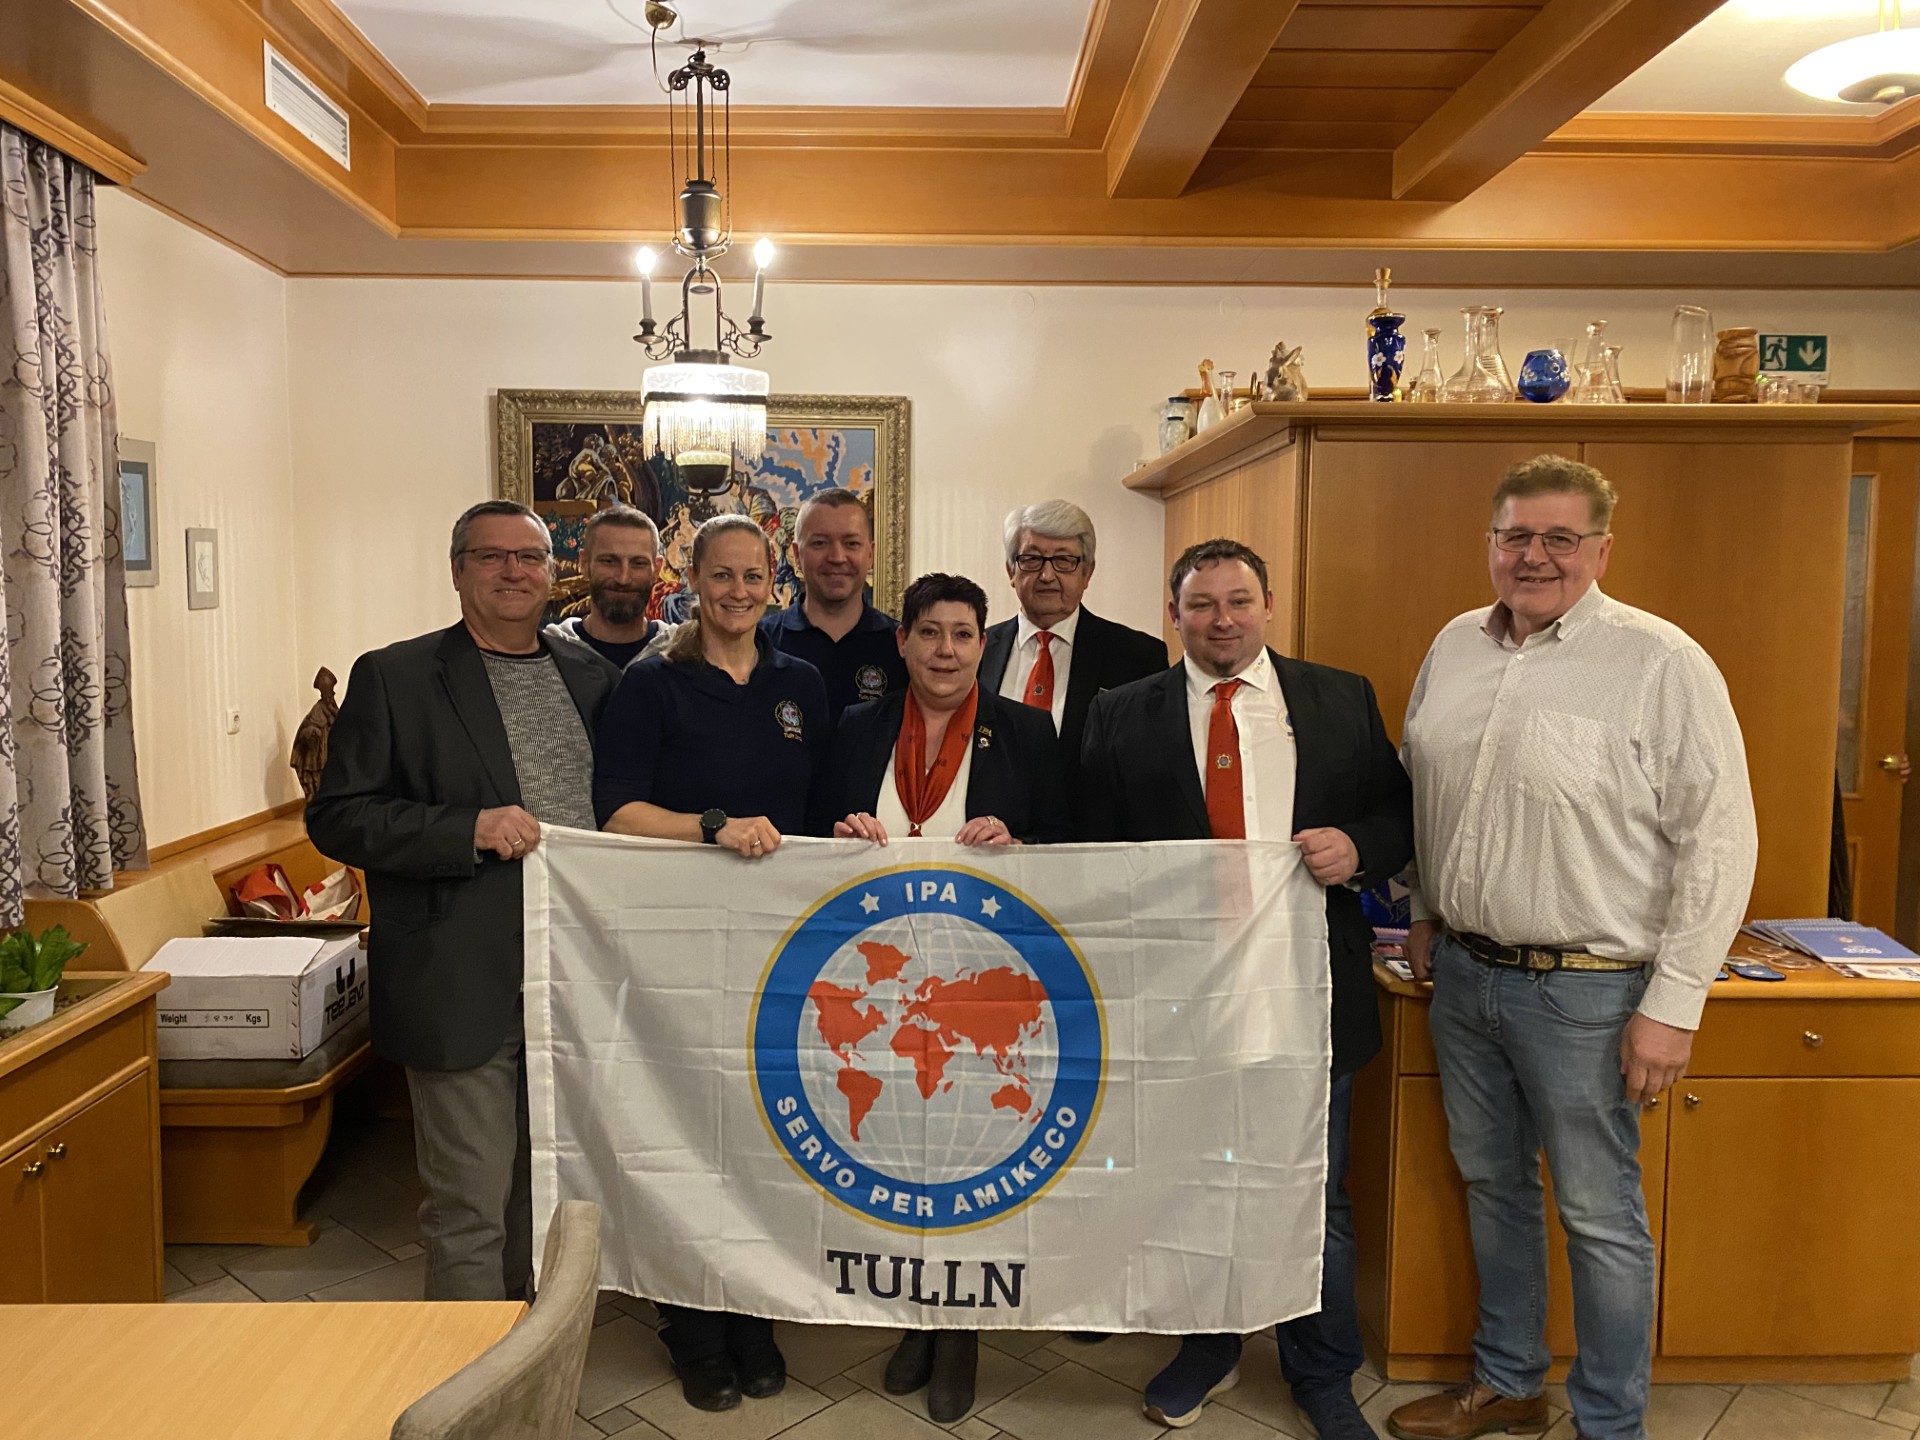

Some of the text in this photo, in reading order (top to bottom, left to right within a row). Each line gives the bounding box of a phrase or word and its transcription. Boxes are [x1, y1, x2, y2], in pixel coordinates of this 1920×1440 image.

[905, 881, 957, 903] IPA
[160, 1013, 187, 1025] Weight
[245, 1013, 261, 1025] Kgs
[777, 1096, 1077, 1217] SERVO PER AMIKECO
[826, 1249, 1026, 1308] TULLN
